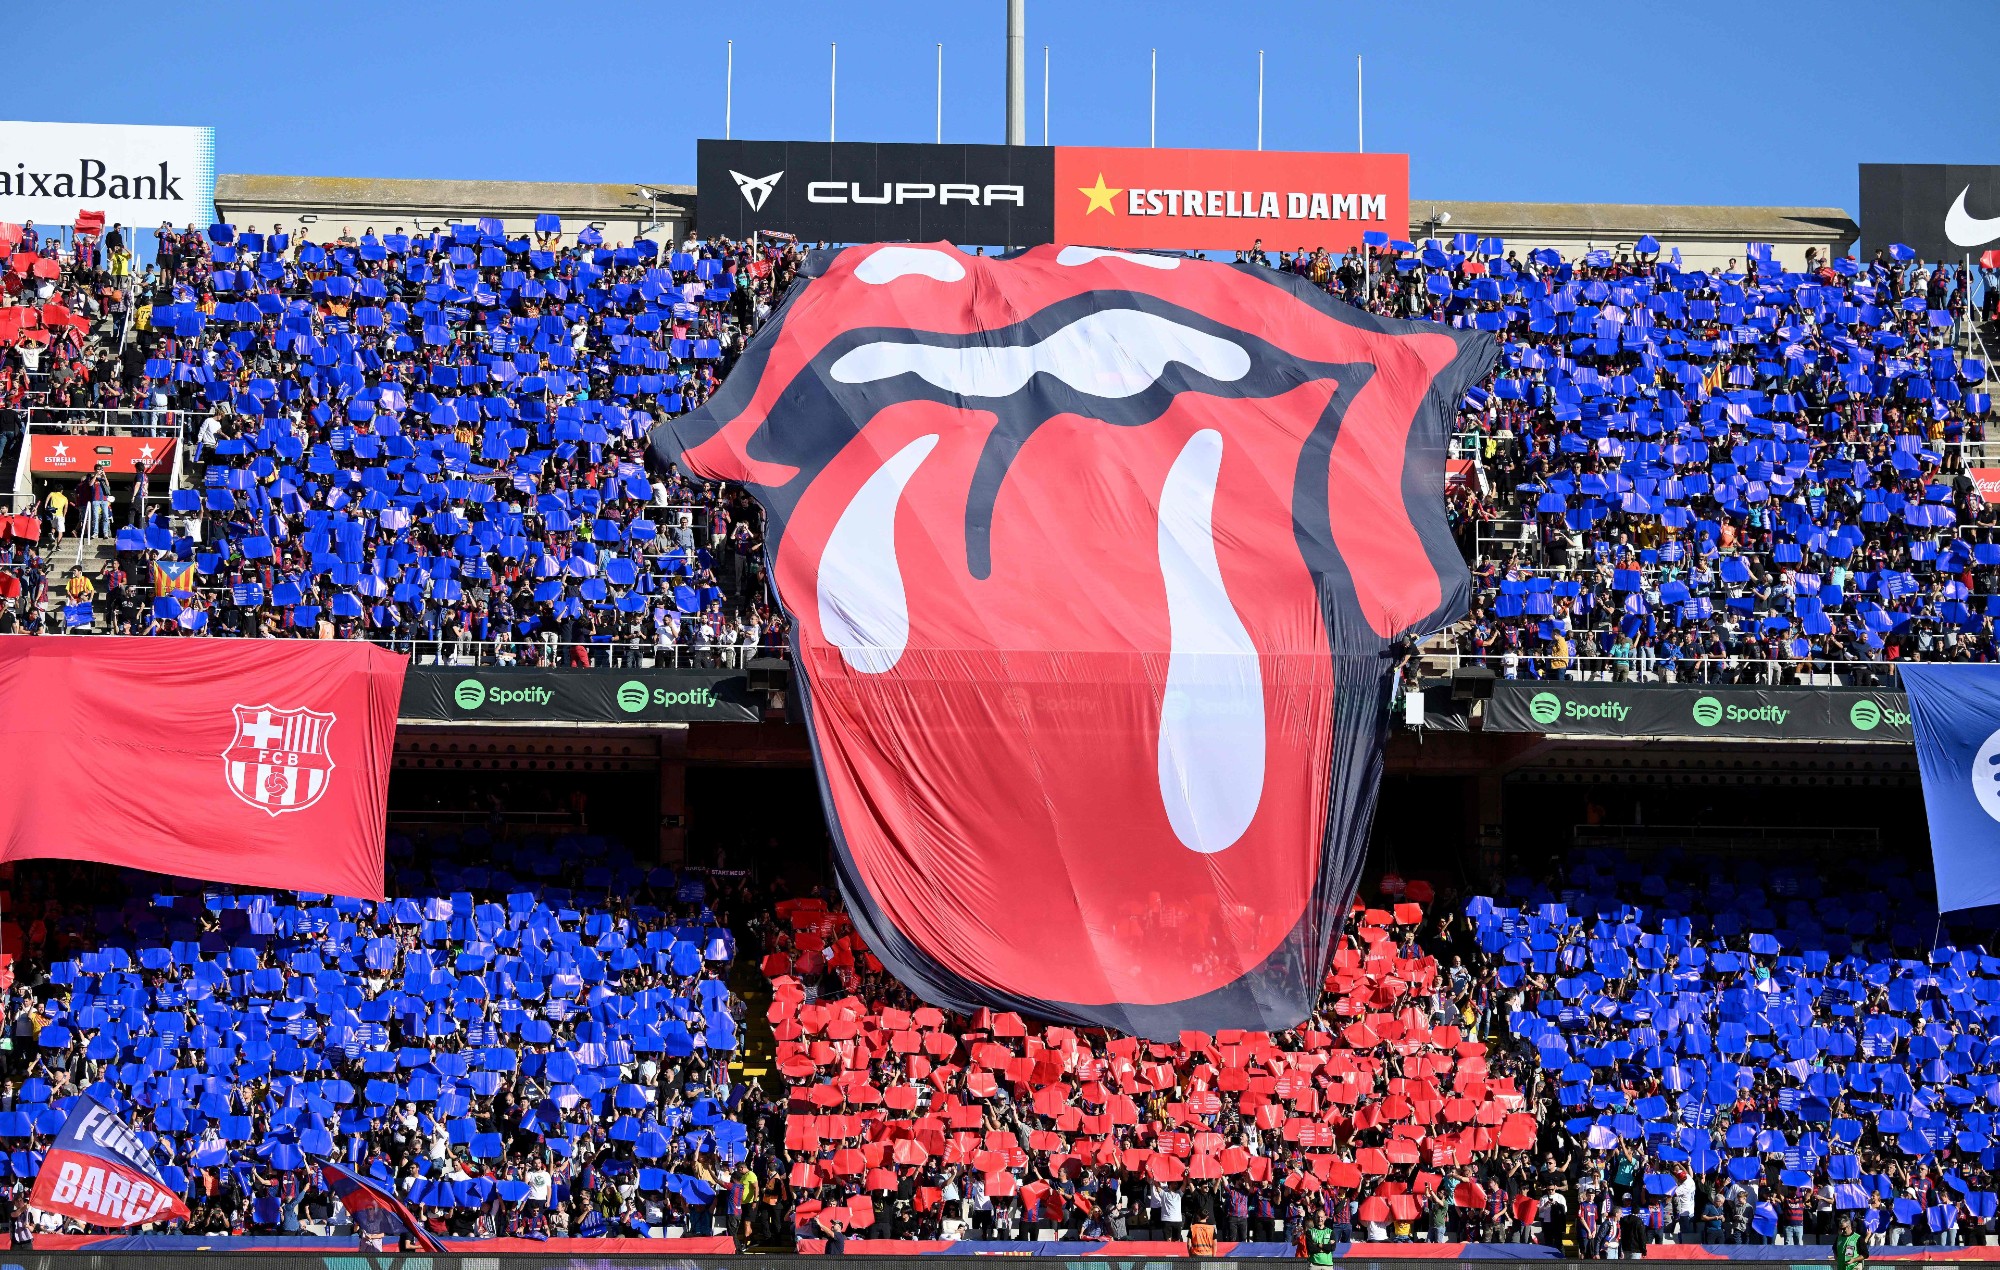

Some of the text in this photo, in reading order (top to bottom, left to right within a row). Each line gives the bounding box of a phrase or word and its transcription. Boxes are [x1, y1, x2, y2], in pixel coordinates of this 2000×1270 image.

[808, 181, 1024, 206] CUPRA
[1128, 188, 1387, 221] ESTRELLA DAMM
[489, 686, 553, 705] Spotify
[653, 688, 718, 707] Spotify
[1565, 701, 1629, 722] Spotify
[1726, 704, 1788, 725] Spotify
